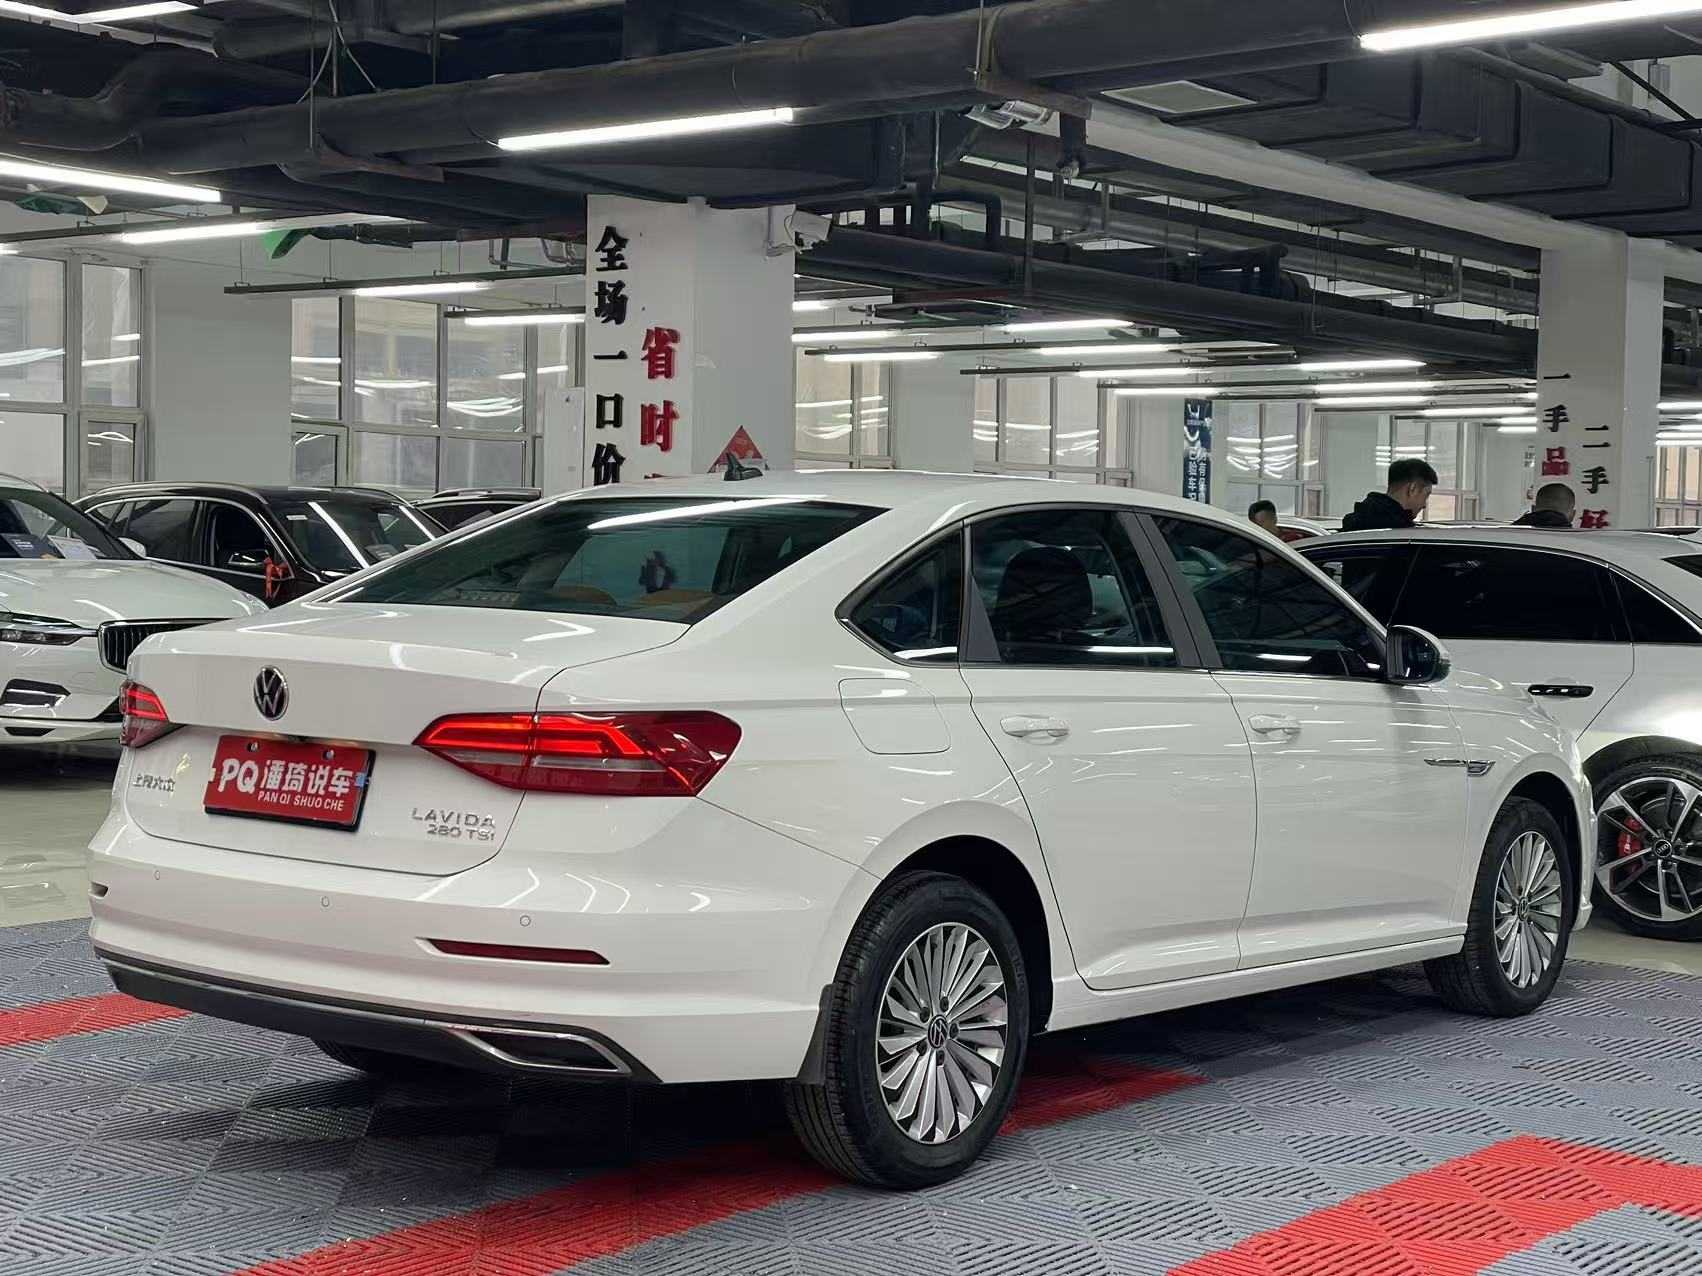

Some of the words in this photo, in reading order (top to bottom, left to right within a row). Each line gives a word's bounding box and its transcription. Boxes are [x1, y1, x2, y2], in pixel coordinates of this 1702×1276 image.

[592, 226, 629, 486] 全场一口价
[640, 326, 681, 479] 省时
[1542, 373, 1571, 476] 一手品
[217, 758, 259, 794] PQ
[258, 791, 278, 803] PAN
[279, 794, 291, 804] QI
[293, 795, 322, 808] SHUO
[323, 799, 344, 811] CHE
[412, 808, 495, 829] LAVIDA
[427, 823, 460, 838] 280
